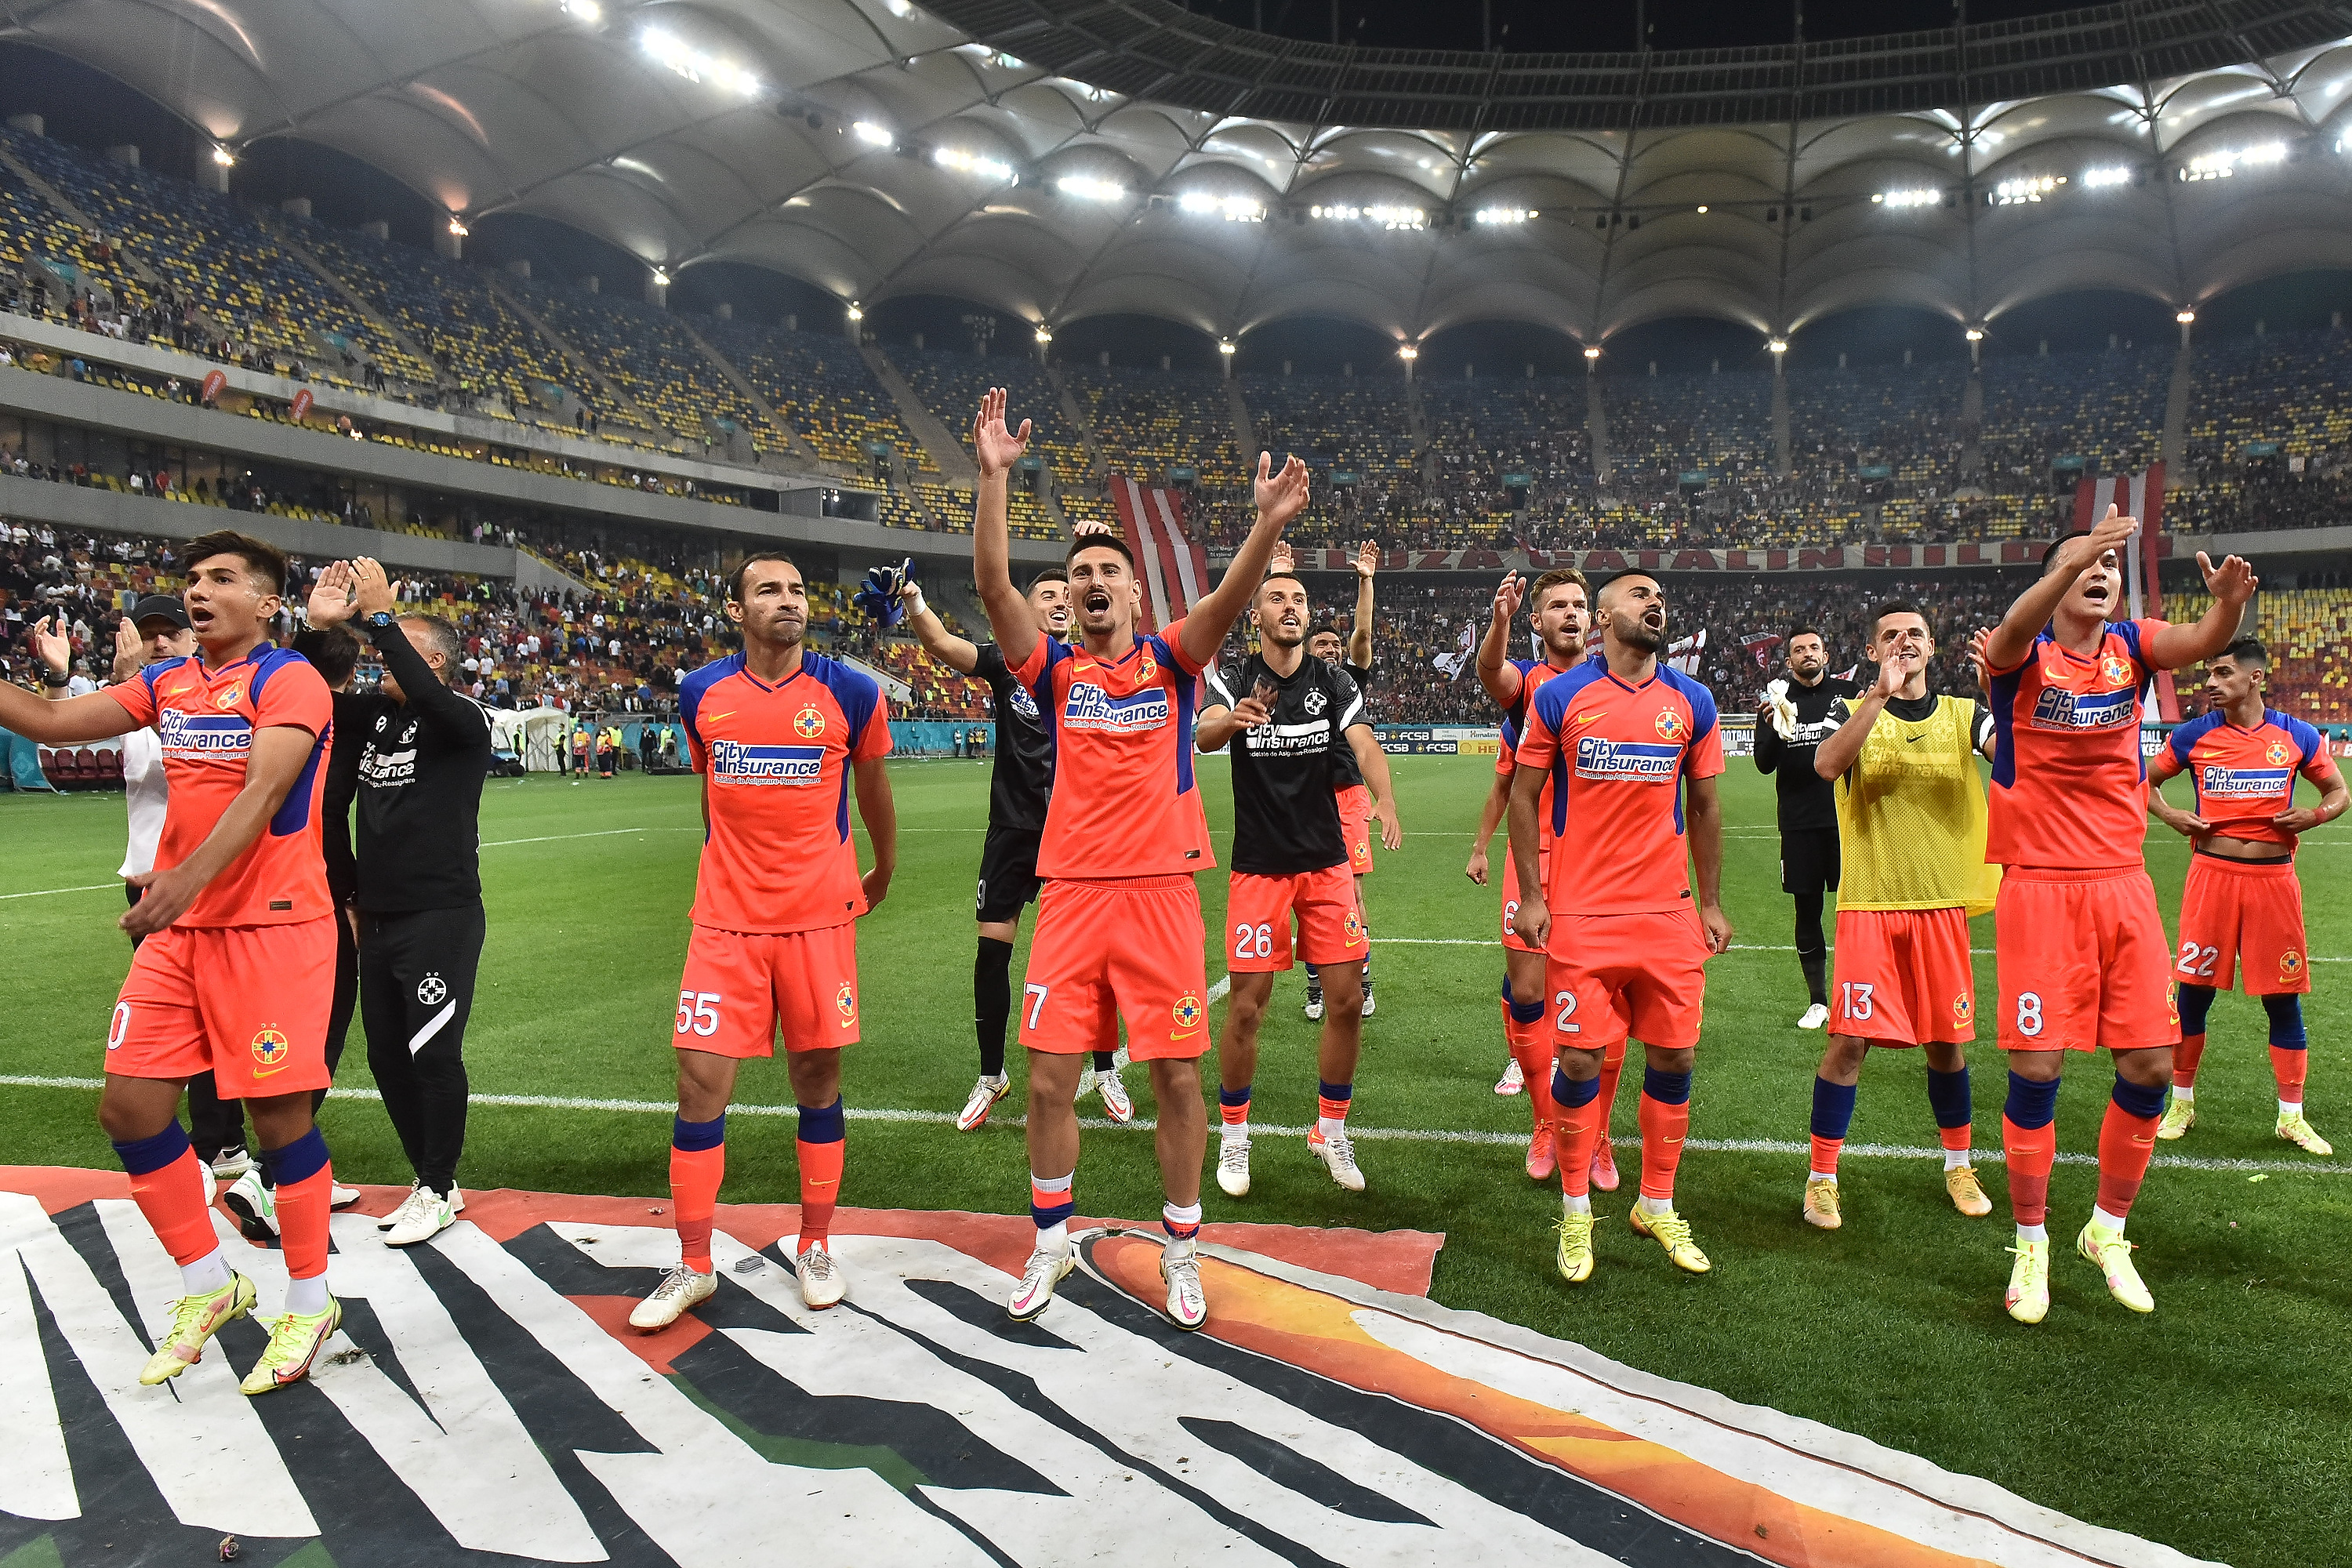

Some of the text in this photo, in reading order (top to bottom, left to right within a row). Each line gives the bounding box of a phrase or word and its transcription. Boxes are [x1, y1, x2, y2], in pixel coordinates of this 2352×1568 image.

[1529, 550, 1845, 571] CATALIN
[1069, 684, 1106, 705] City
[2040, 688, 2078, 713] City
[161, 710, 190, 734] City
[1077, 702, 1167, 722] Insurance
[164, 729, 252, 748] Insurance
[1256, 731, 1330, 749] Insurance
[1399, 731, 1429, 741] FCSB
[713, 742, 750, 764] City
[1425, 743, 1457, 753] FCSB
[1578, 738, 1619, 760] City
[723, 759, 820, 775] Insurance
[1589, 754, 1676, 771] Insurance
[2205, 768, 2234, 782] City
[2212, 779, 2287, 790] Insurance
[976, 879, 987, 910] 9
[1235, 923, 1273, 959] 26
[2176, 942, 2219, 977] 22
[1555, 990, 1581, 1033] 2
[1842, 982, 1874, 1021] 13
[676, 989, 721, 1037] 55
[2016, 991, 2044, 1036] 8
